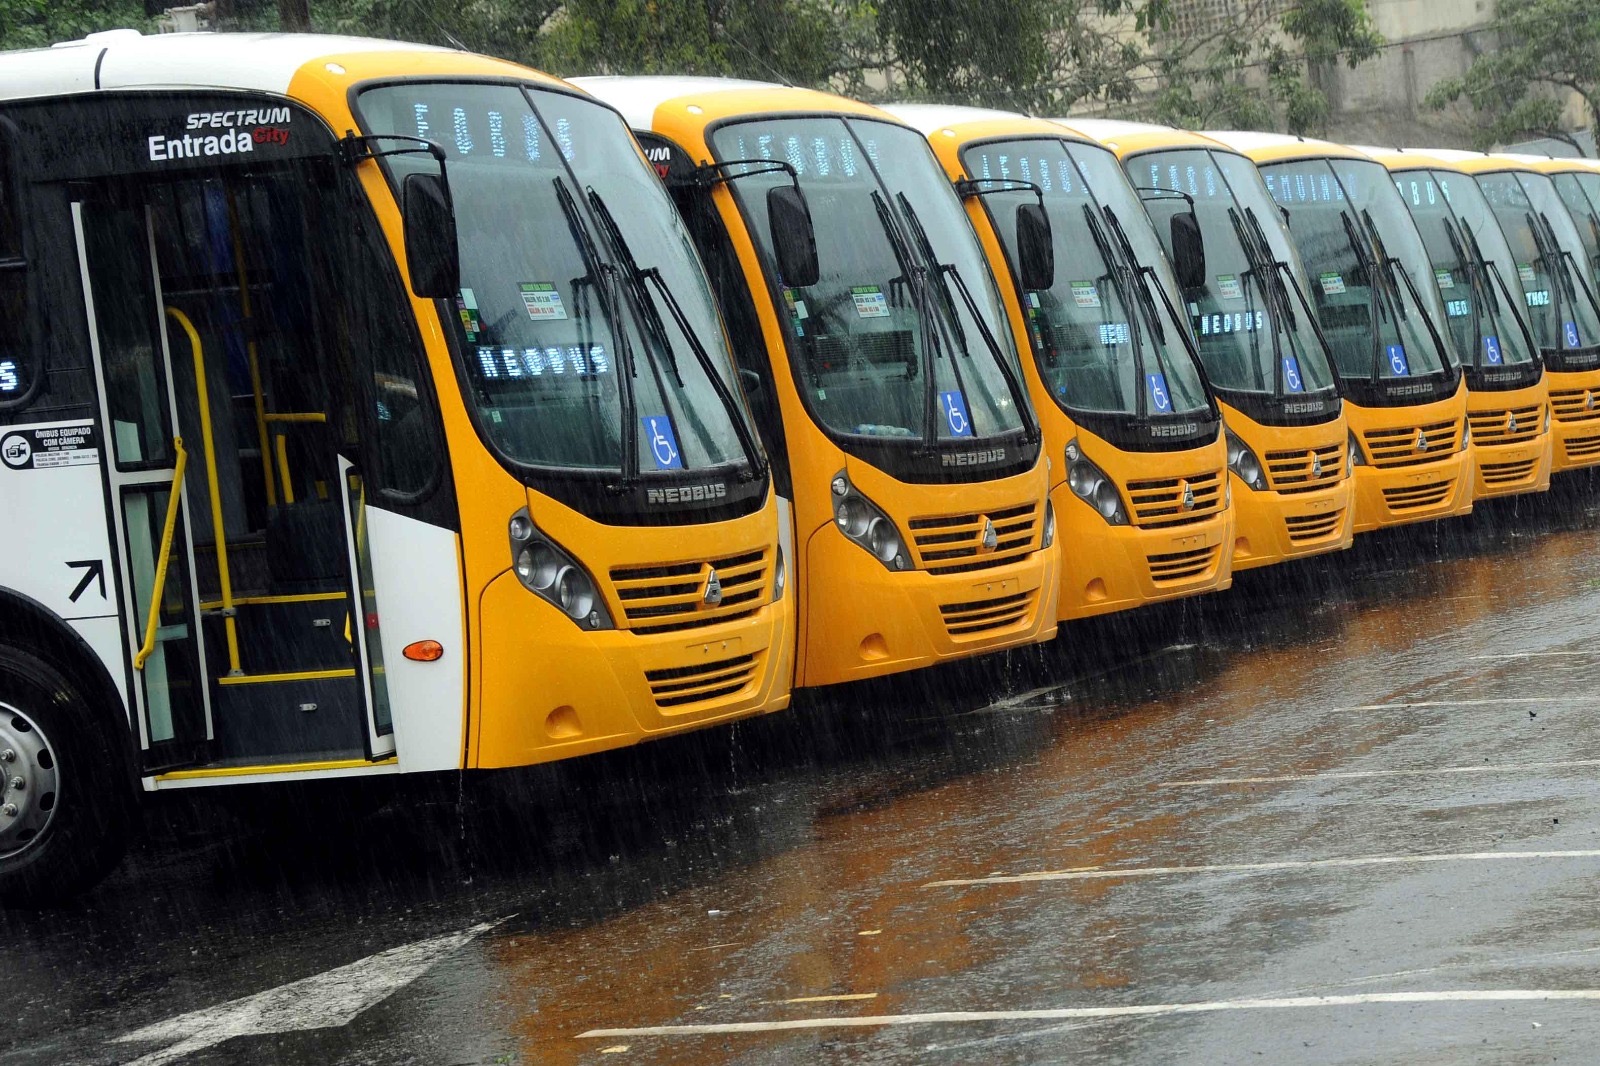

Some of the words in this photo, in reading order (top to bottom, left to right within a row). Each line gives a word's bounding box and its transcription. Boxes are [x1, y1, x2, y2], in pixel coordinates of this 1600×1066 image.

[187, 107, 290, 129] SPECTRUM
[149, 129, 253, 161] Entrada
[252, 127, 289, 146] City
[1201, 311, 1262, 335] NEOBUS
[1386, 383, 1433, 396] NEOBUS
[1284, 401, 1324, 414] NEOBUS
[60, 427, 91, 437] EQUIPADO
[1151, 423, 1197, 437] NEOBUS
[43, 438, 58, 447] COM
[58, 436, 85, 445] CÂMERA
[942, 448, 1005, 467] NEOBUS
[646, 483, 726, 505] NEOBUS
